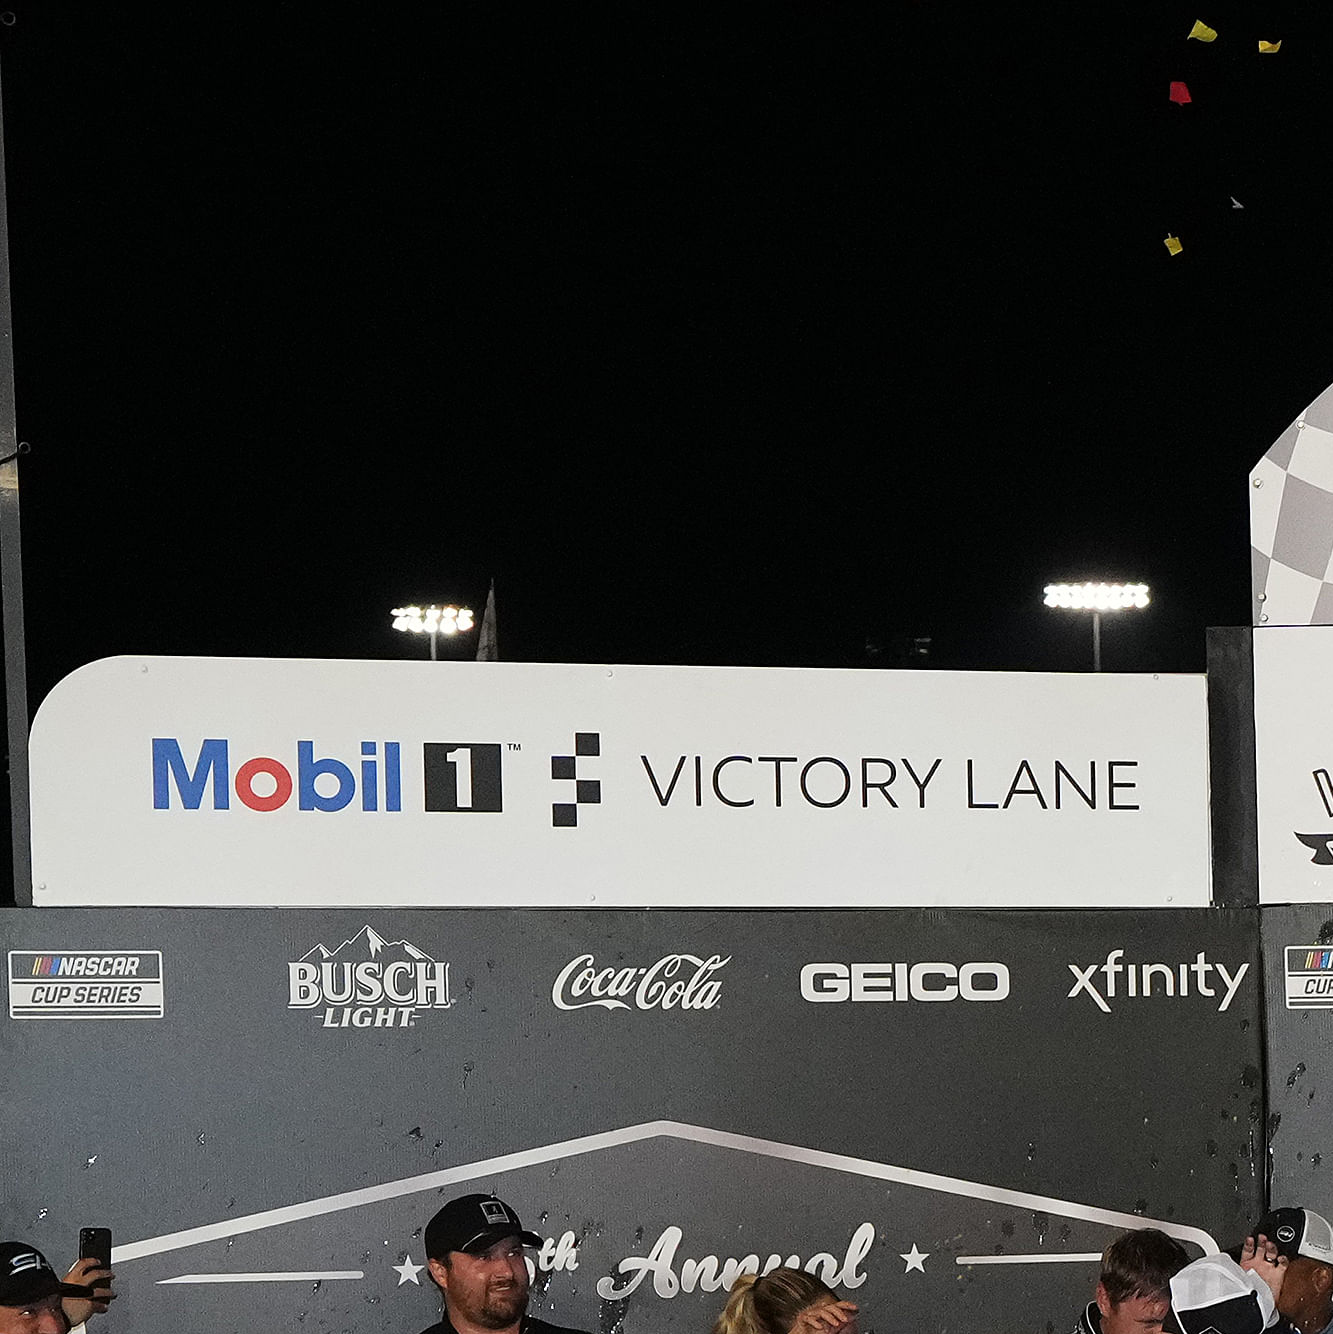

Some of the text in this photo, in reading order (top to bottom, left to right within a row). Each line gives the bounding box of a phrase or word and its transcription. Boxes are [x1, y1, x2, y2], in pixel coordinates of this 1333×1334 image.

[152, 738, 473, 812] Mobil 1
[641, 755, 1140, 810] VICTORY LANE
[58, 955, 139, 976] NASCAR
[289, 960, 450, 1010] BUSCH
[552, 953, 732, 1011] Coca-Cola
[800, 962, 1011, 1003] GEICO
[1067, 949, 1250, 1012] xfinity
[31, 985, 142, 1004] CUP SERIES
[322, 1007, 411, 1028] LIGHT
